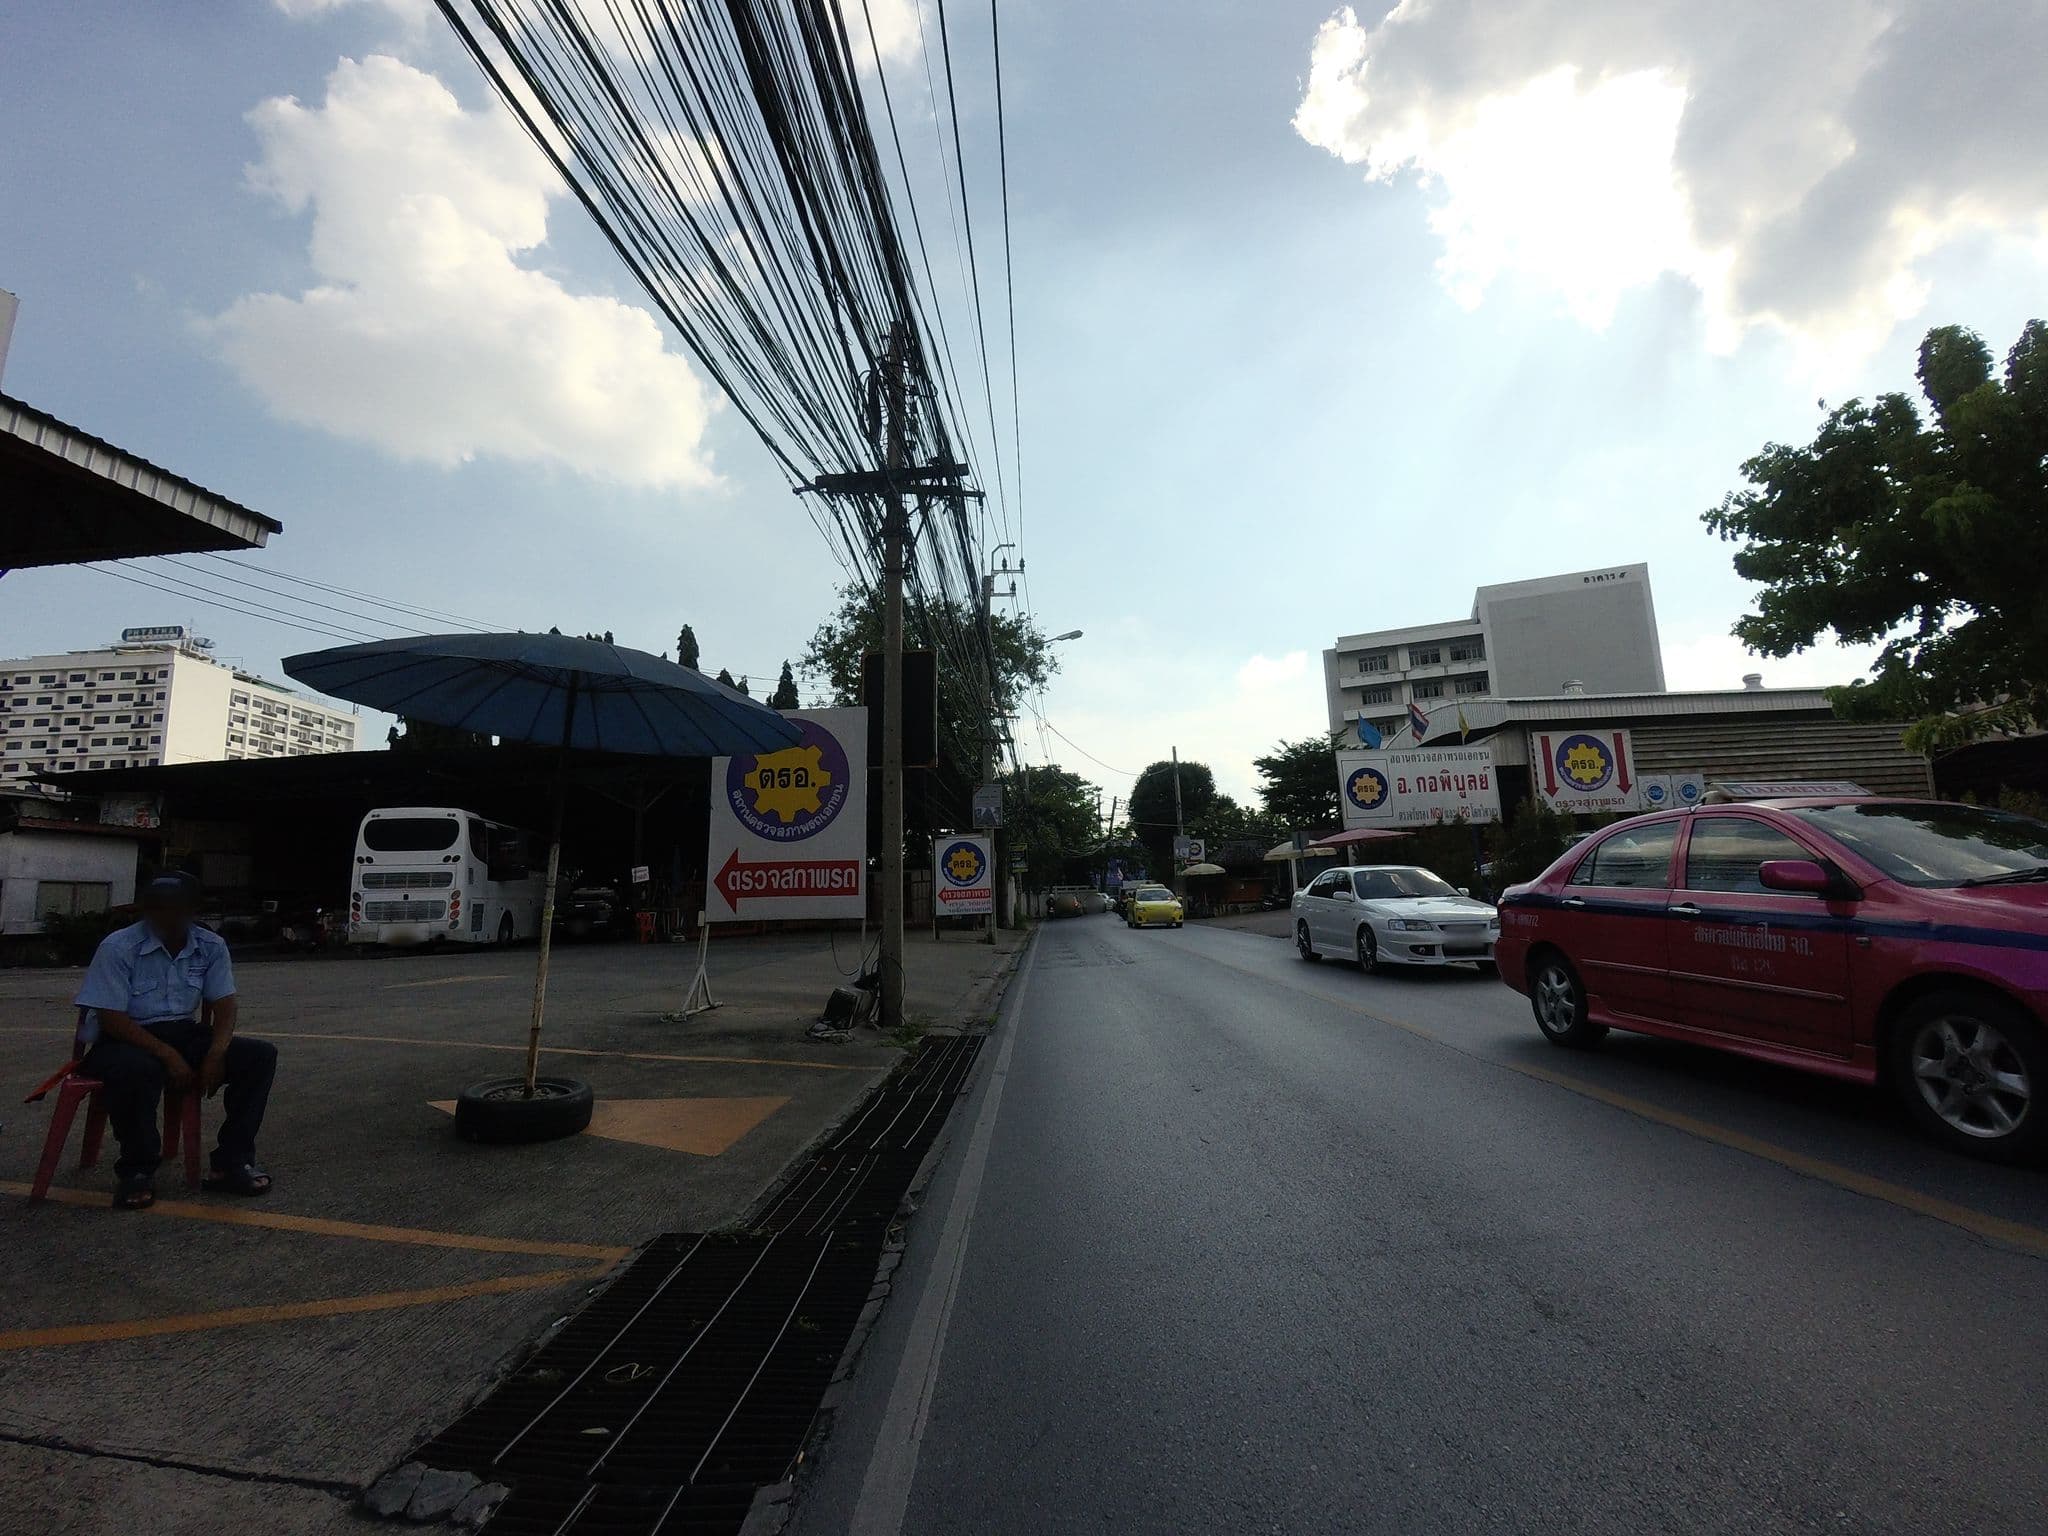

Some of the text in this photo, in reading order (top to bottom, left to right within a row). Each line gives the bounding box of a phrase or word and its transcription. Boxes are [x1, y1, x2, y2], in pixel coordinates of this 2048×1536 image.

[759, 768, 816, 788] ตรอ.
[1416, 766, 1490, 798] กอพิบูลย์
[727, 867, 857, 891] ตรวจสภาพรถ
